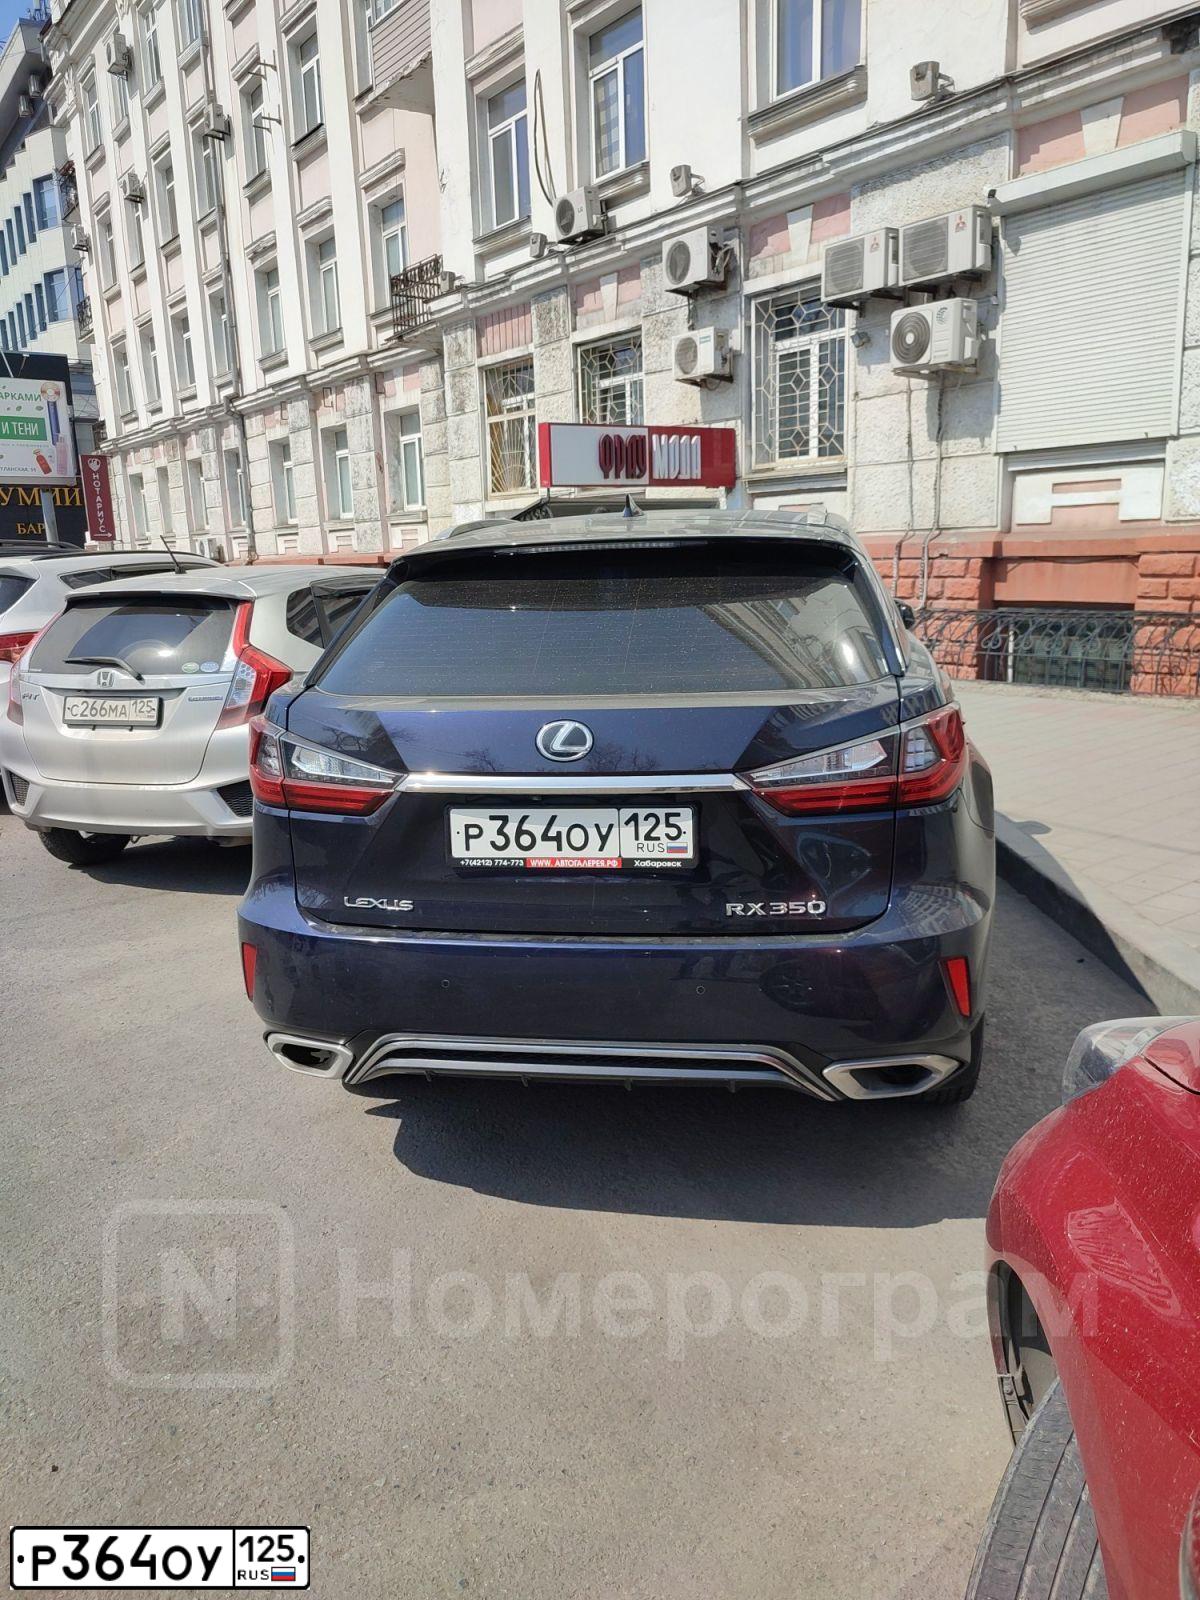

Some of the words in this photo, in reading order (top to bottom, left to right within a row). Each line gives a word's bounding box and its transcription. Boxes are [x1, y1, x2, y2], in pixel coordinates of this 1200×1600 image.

[2, 421, 10, 435] И
[12, 422, 39, 436] ТЕНИ
[651, 433, 702, 480] МОДА
[92, 472, 106, 533] НОТАРИУС
[16, 522, 45, 535] БАР
[132, 700, 154, 714] 125
[624, 812, 682, 842] 125
[636, 843, 666, 853] RUS
[634, 859, 682, 868] Хабаровск
[343, 896, 414, 911] LEXUS
